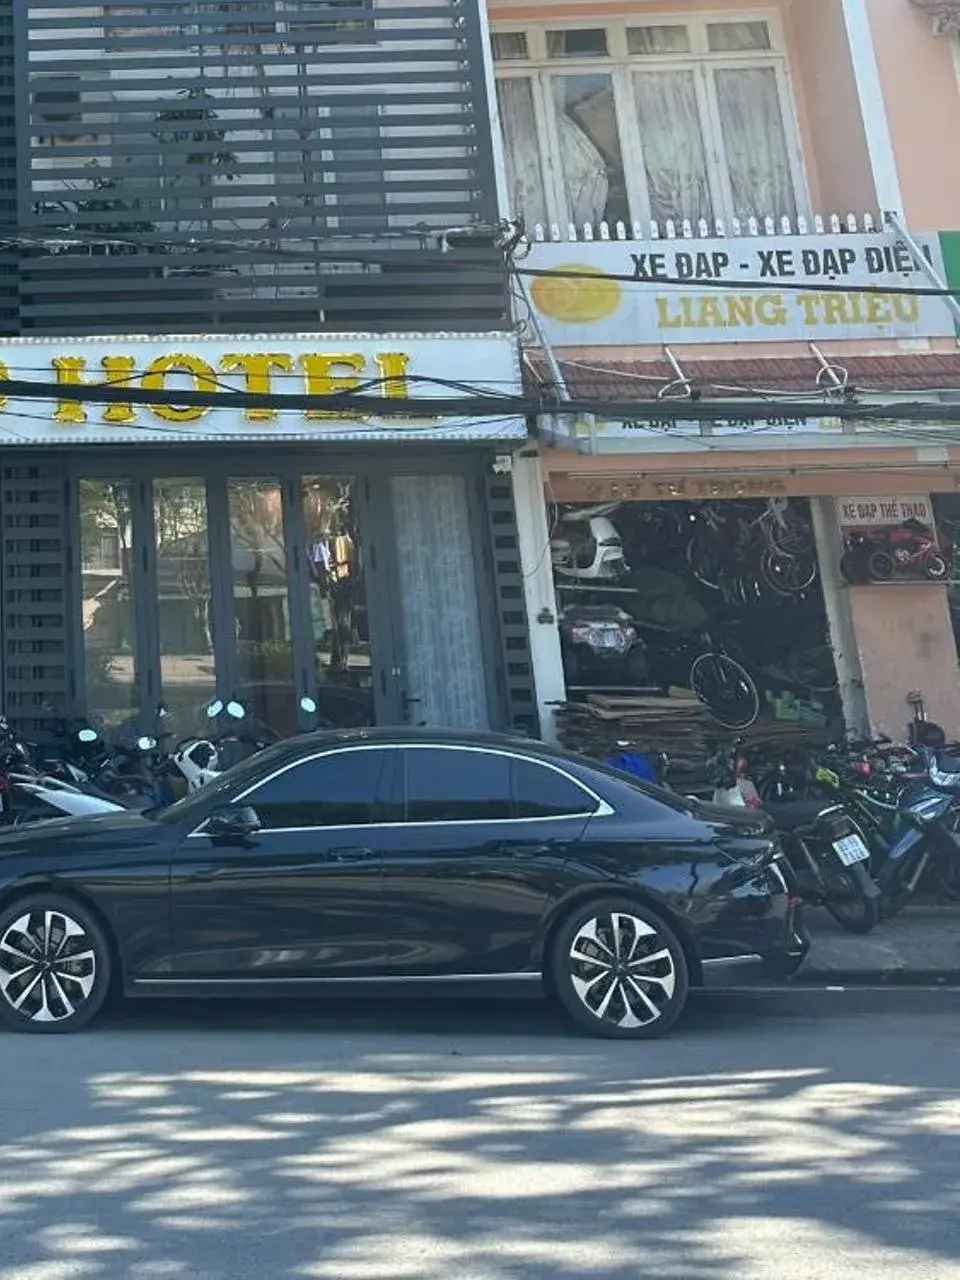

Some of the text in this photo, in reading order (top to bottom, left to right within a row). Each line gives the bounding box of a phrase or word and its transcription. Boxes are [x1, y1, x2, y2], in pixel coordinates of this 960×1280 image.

[630, 252, 666, 279] XE
[758, 250, 796, 277] XE
[803, 247, 856, 280] ĐẠP
[655, 294, 788, 329] LIANG
[51, 350, 444, 424] HOTEL
[842, 503, 857, 519] XE
